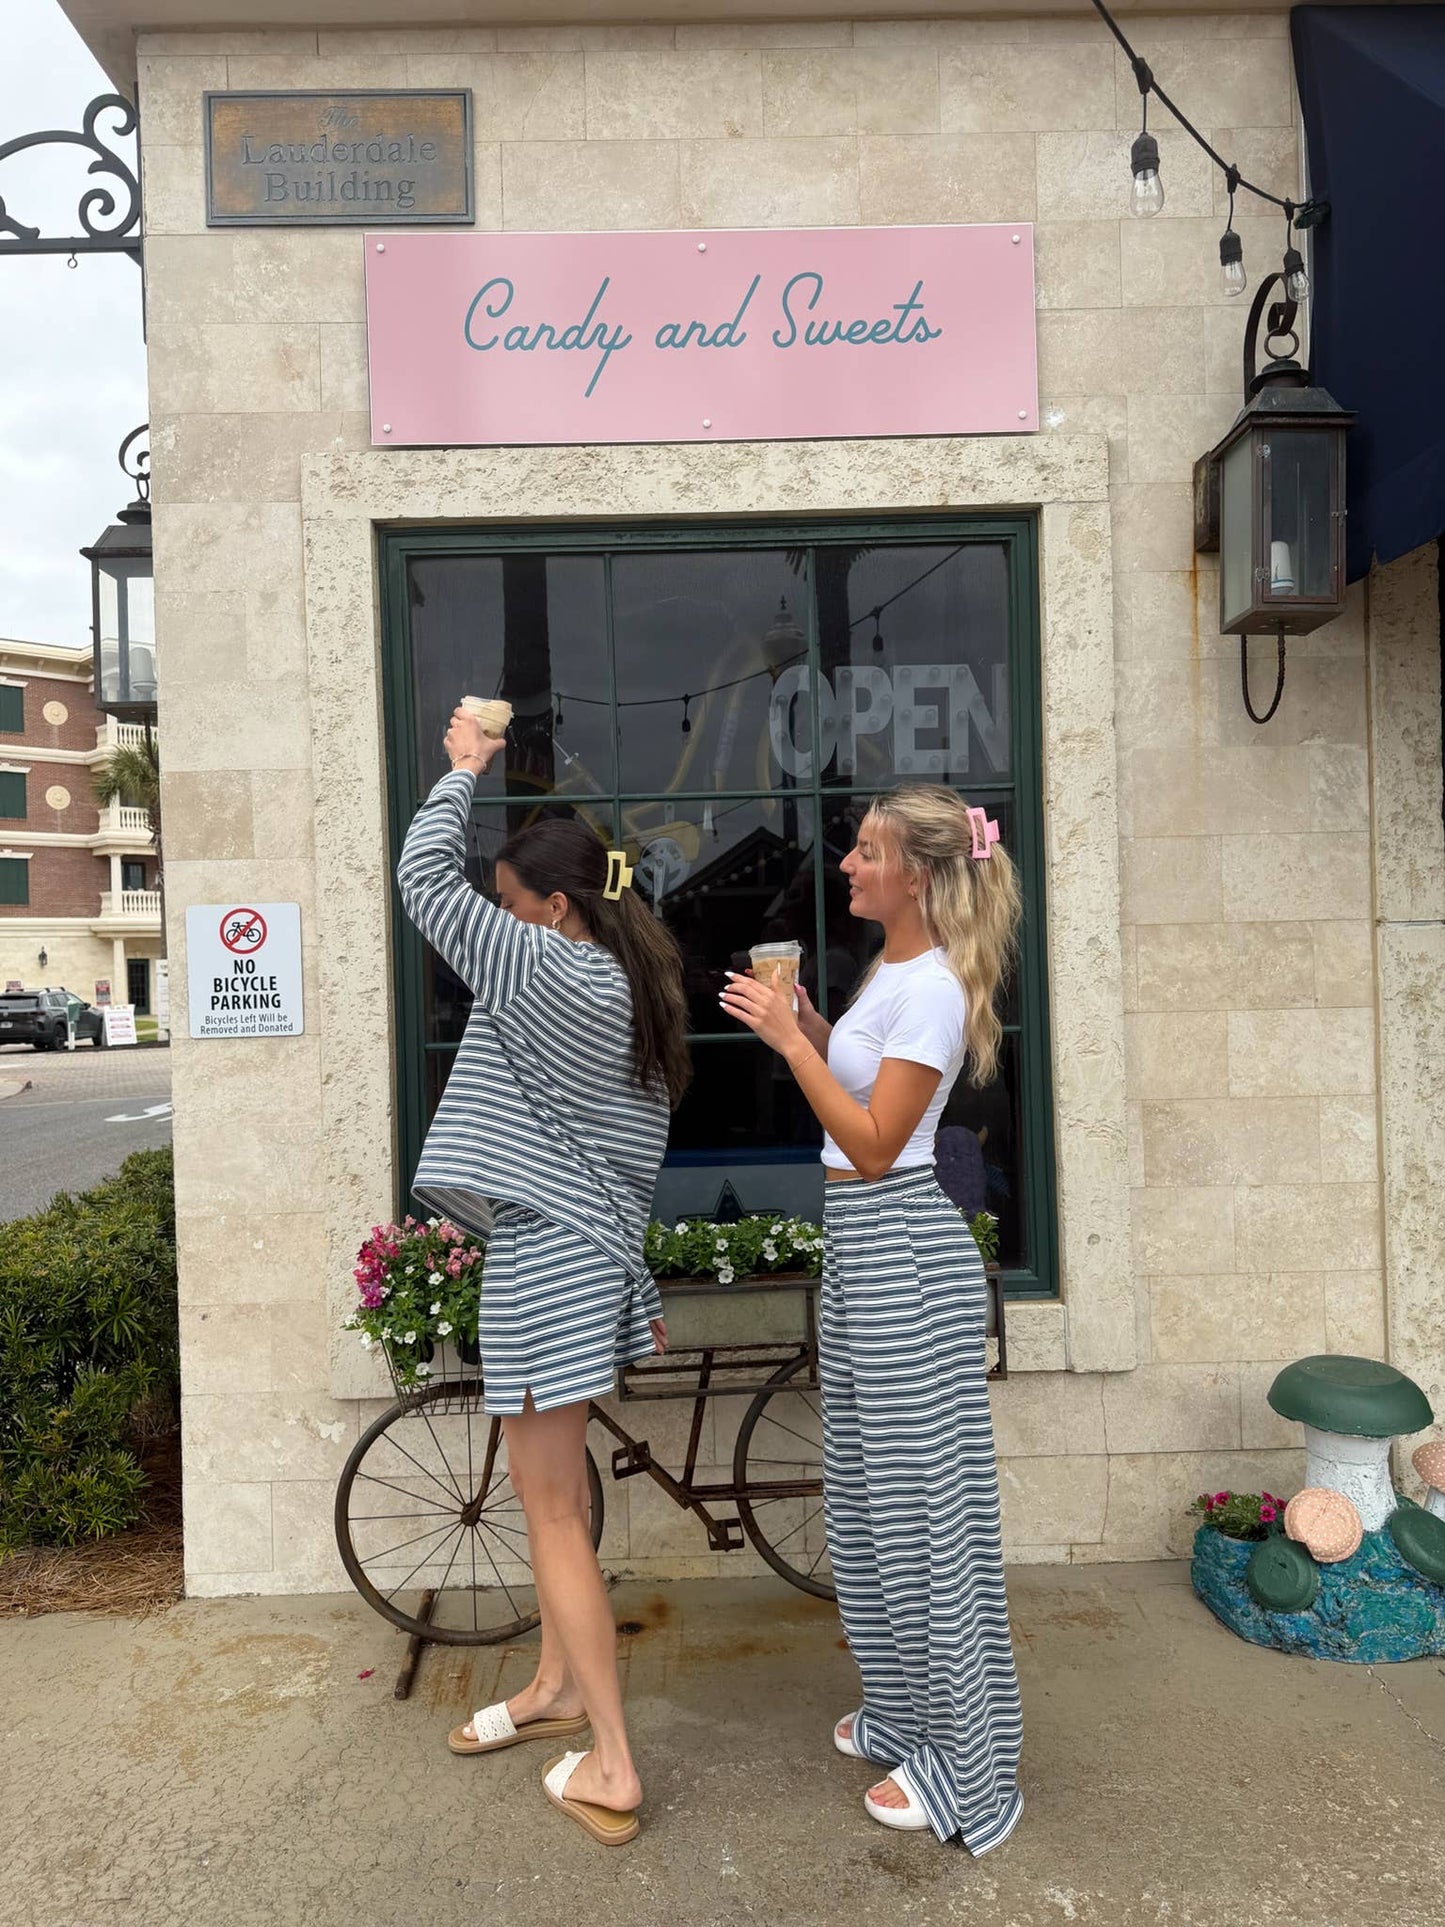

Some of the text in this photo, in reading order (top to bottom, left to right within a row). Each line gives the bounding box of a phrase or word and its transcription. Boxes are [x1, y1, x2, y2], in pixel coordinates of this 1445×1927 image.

[320, 105, 360, 128] The
[241, 132, 438, 166] Lauderdale
[264, 171, 417, 208] Building
[464, 271, 943, 398] Candy and Sweets
[769, 663, 1010, 778] OPEN
[233, 959, 256, 975] NO
[213, 976, 278, 993] BICYCLE
[211, 993, 282, 1011] PARKING
[200, 1022, 294, 1035] Removed and Donated
[205, 1013, 288, 1026] Bicycles Left Will be
